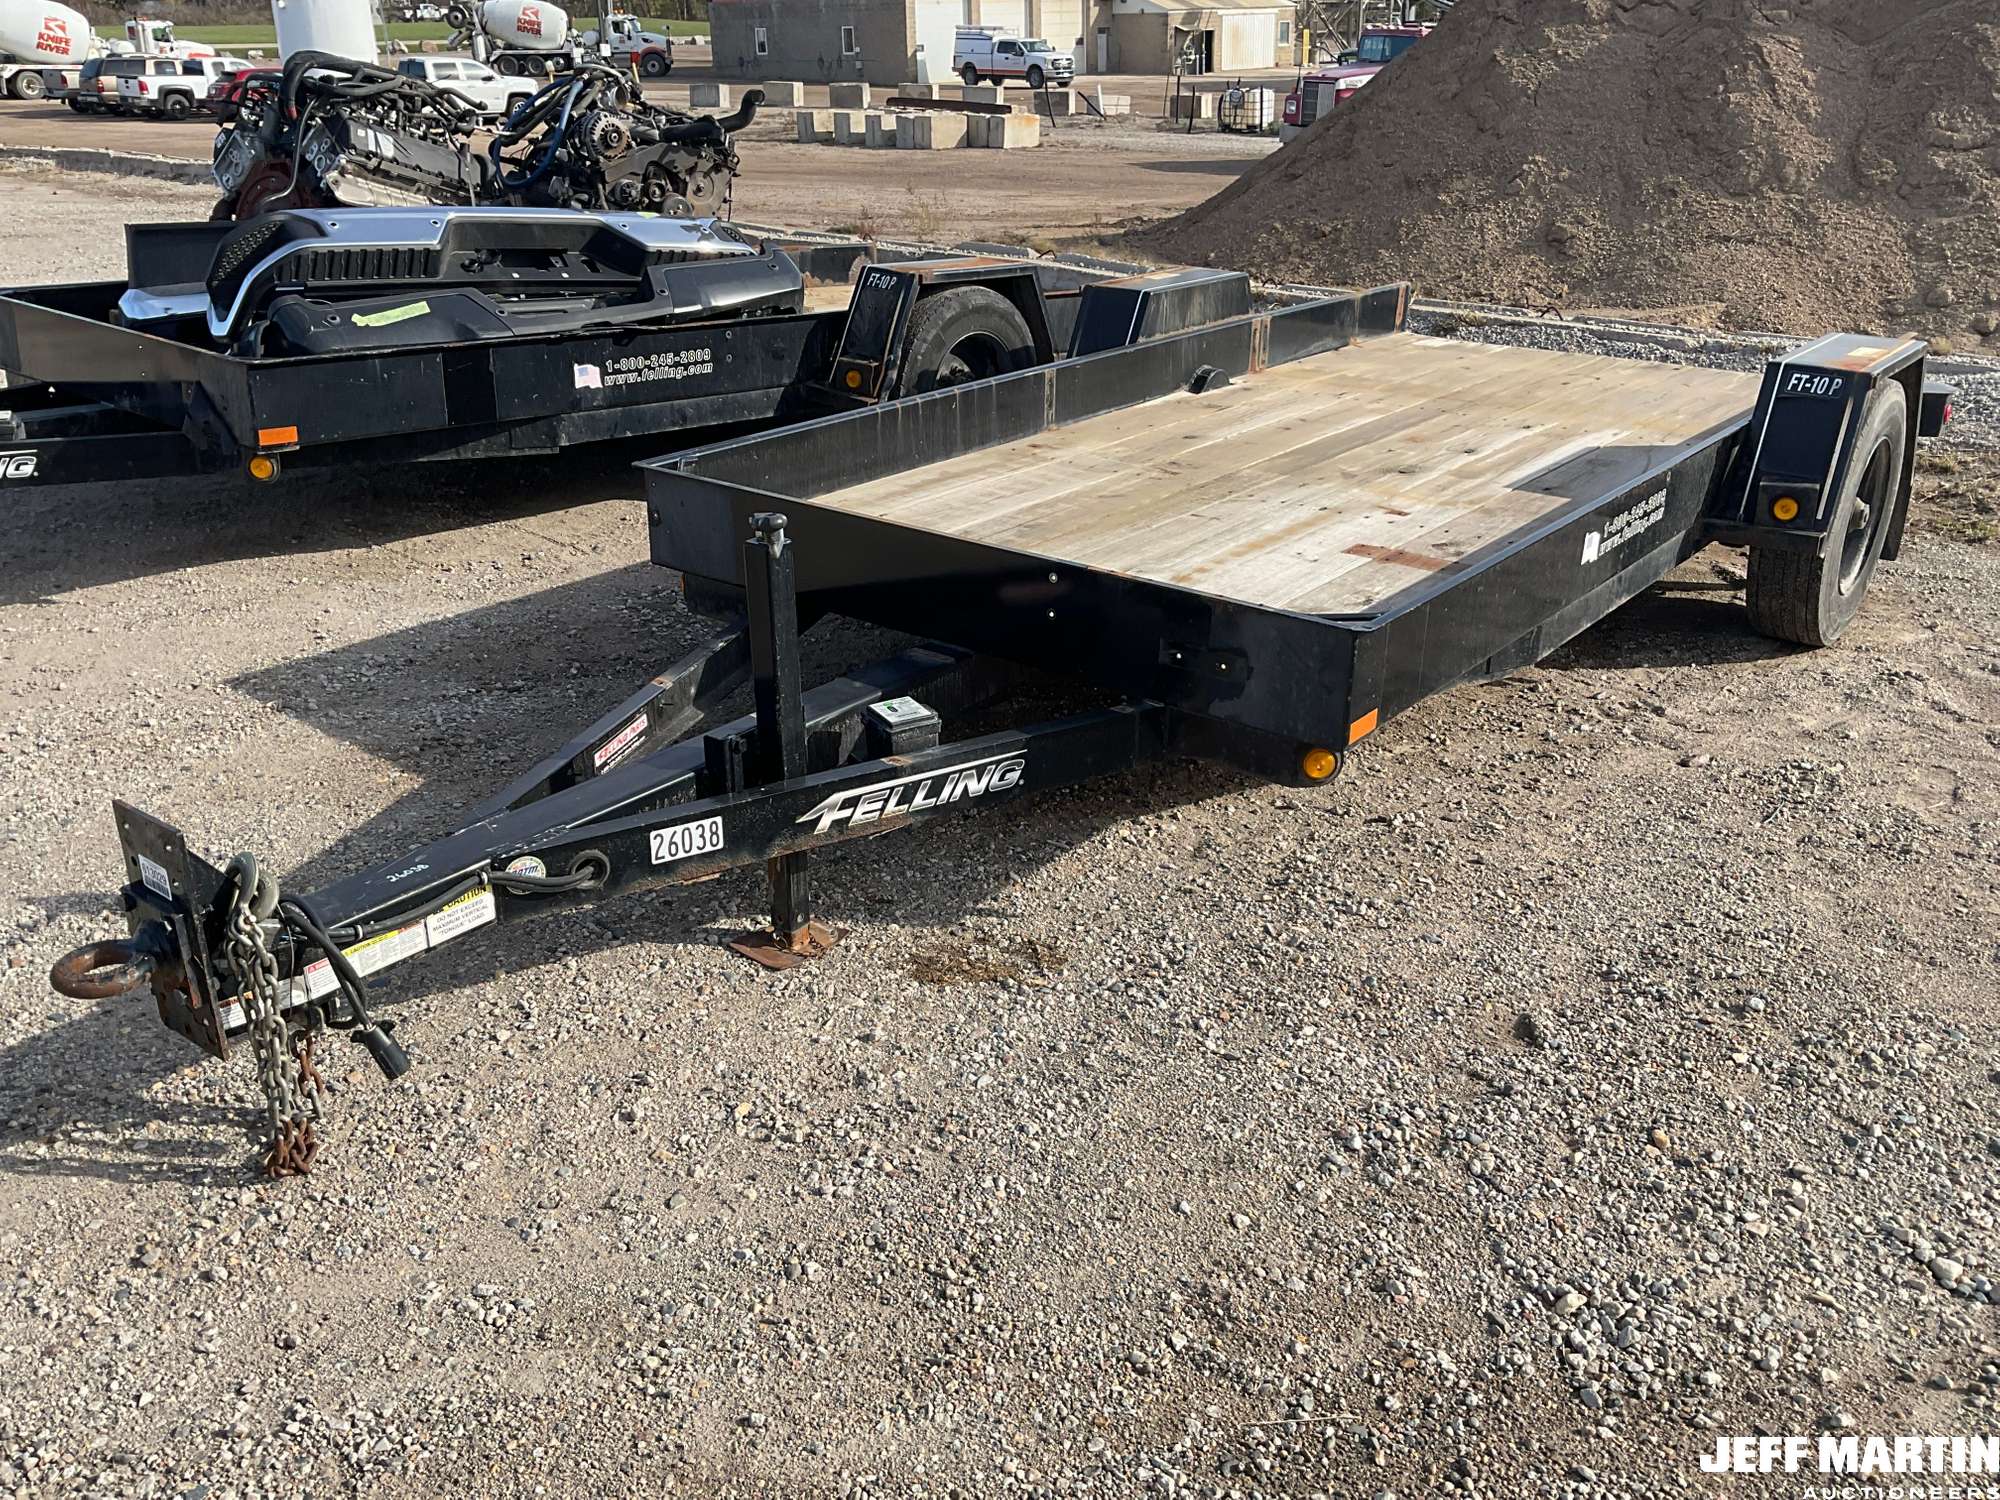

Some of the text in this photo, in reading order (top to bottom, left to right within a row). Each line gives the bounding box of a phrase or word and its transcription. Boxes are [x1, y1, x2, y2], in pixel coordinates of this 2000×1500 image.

[516, 25, 542, 35] RIVER
[517, 17, 542, 28] KNIFE
[36, 41, 70, 55] RIVER
[38, 31, 71, 47] KNIFE
[867, 272, 897, 290] FT-10 P
[605, 348, 711, 372] 1-800-245-2809
[604, 362, 713, 386] www.felling.com
[1787, 373, 1843, 396] FT-10 P
[795, 749, 1028, 835] FELLING
[653, 820, 720, 861] 26038
